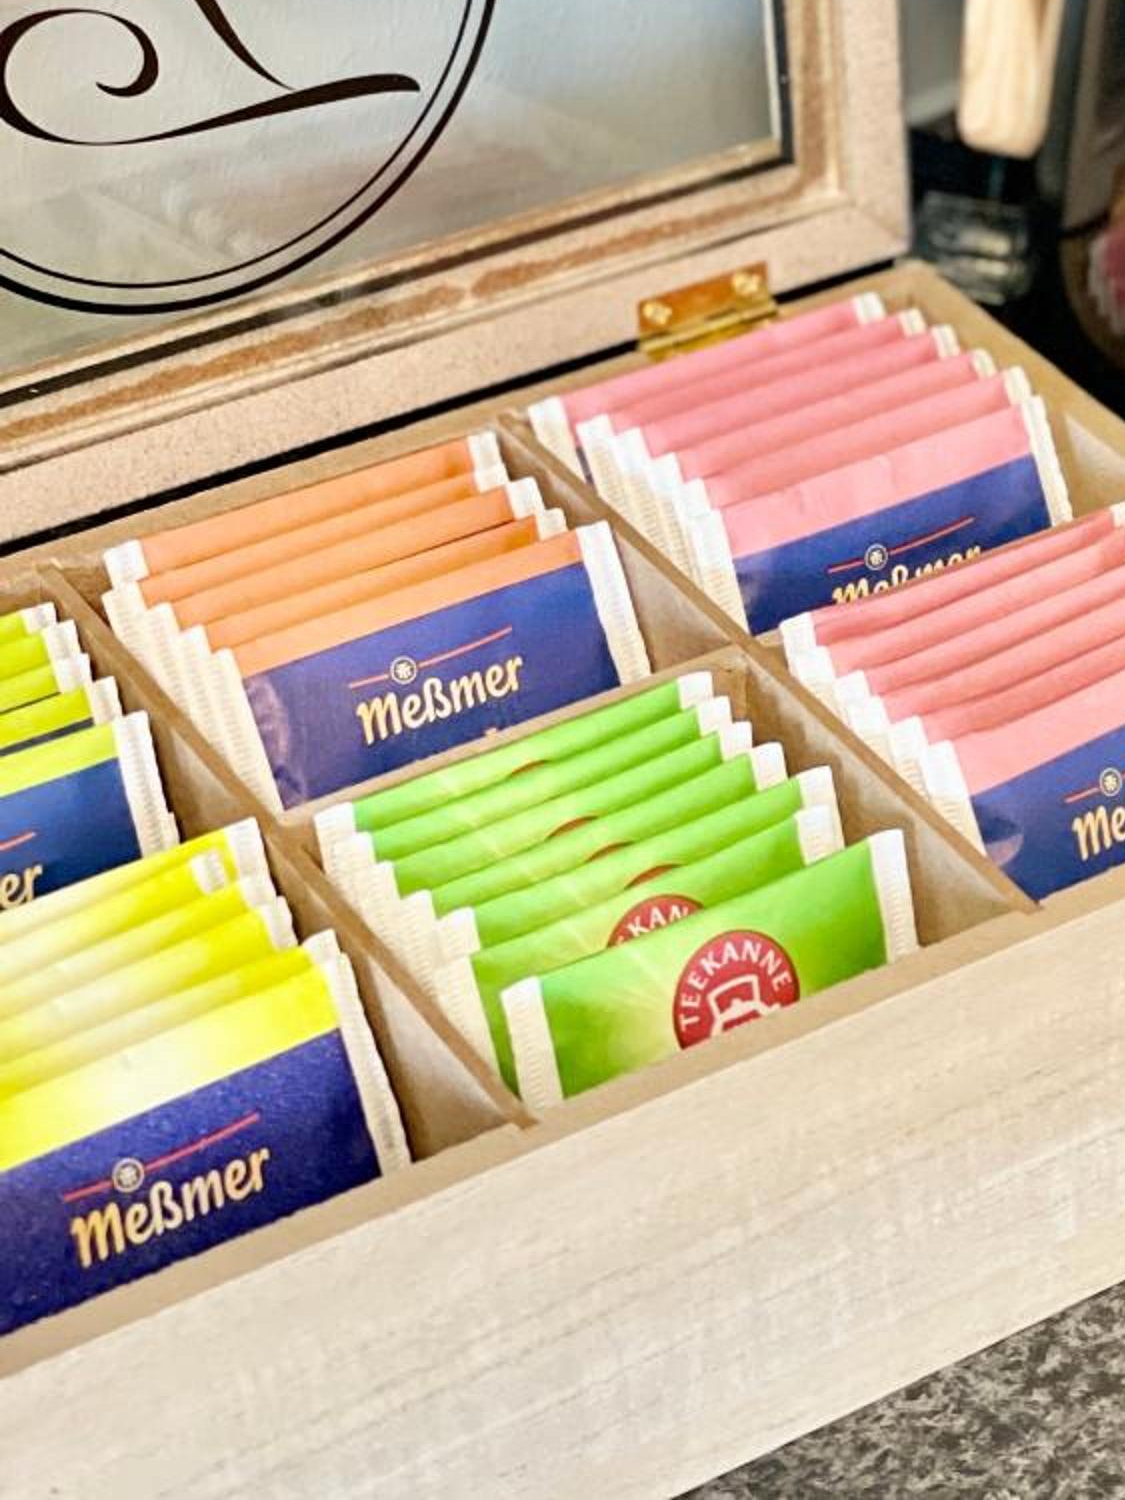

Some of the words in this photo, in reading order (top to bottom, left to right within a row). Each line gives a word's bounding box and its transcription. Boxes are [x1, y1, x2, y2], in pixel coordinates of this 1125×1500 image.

[355, 655, 524, 746] Meßmer
[679, 939, 793, 1032] TEEKANNE
[70, 1147, 270, 1269] Meßmer
